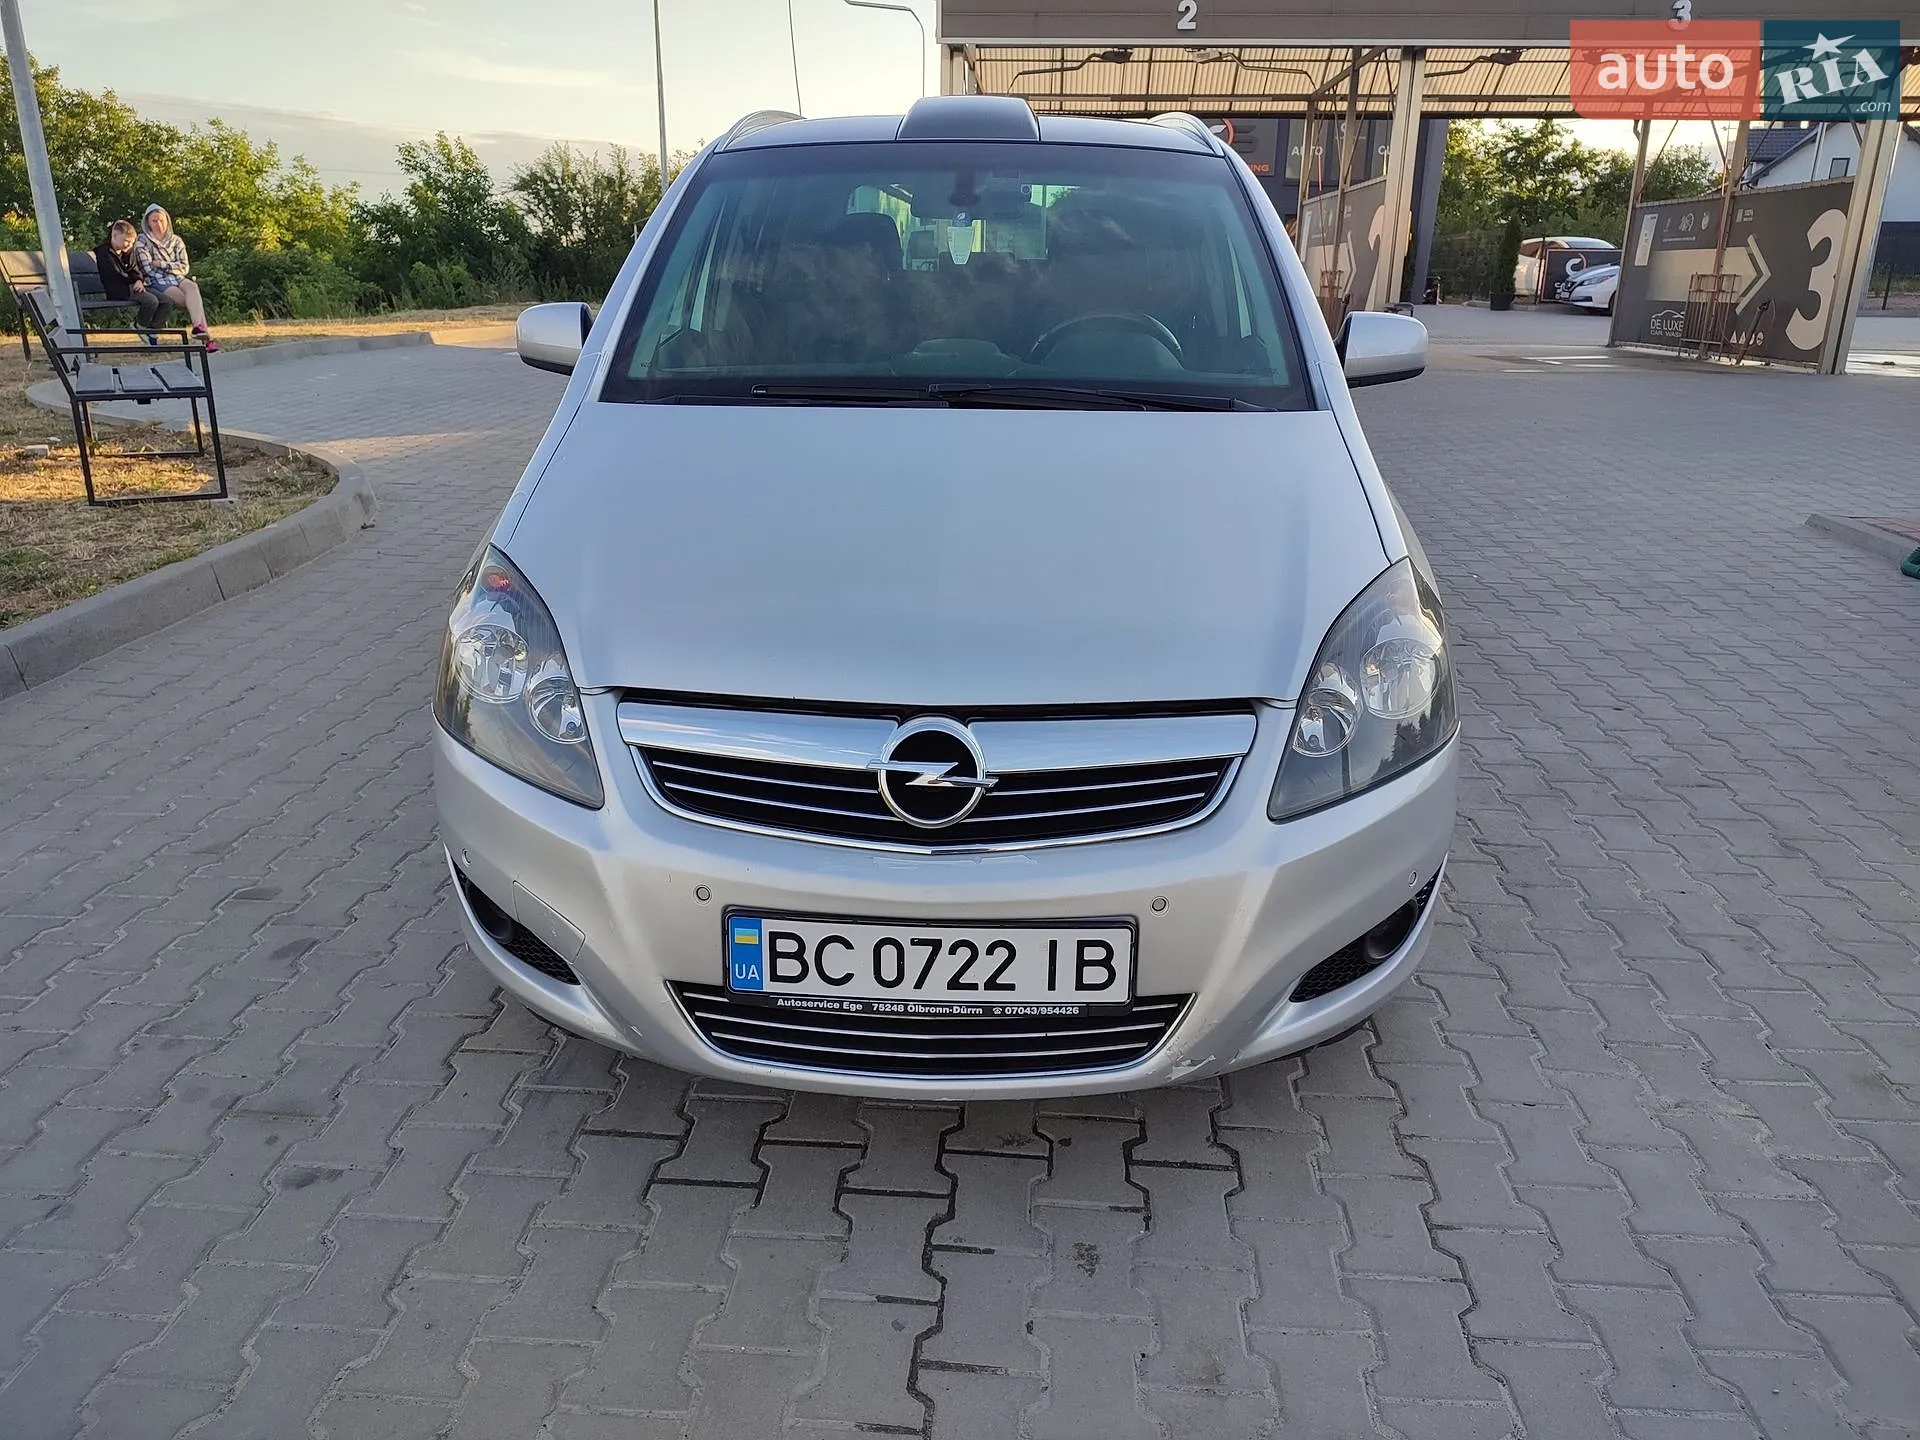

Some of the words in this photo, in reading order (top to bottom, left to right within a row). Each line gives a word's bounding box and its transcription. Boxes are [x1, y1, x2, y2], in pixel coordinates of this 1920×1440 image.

[1178, 0, 1198, 30] 2
[1669, 0, 1693, 31] 3
[1785, 208, 1848, 351] 3
[735, 963, 760, 981] UA
[768, 931, 855, 988] BC
[872, 937, 1017, 991] 0722
[1047, 939, 1118, 992] IB
[777, 998, 840, 1010] Autoservice
[843, 1001, 863, 1012] Ege
[1005, 1006, 1080, 1015] 07043/954426
